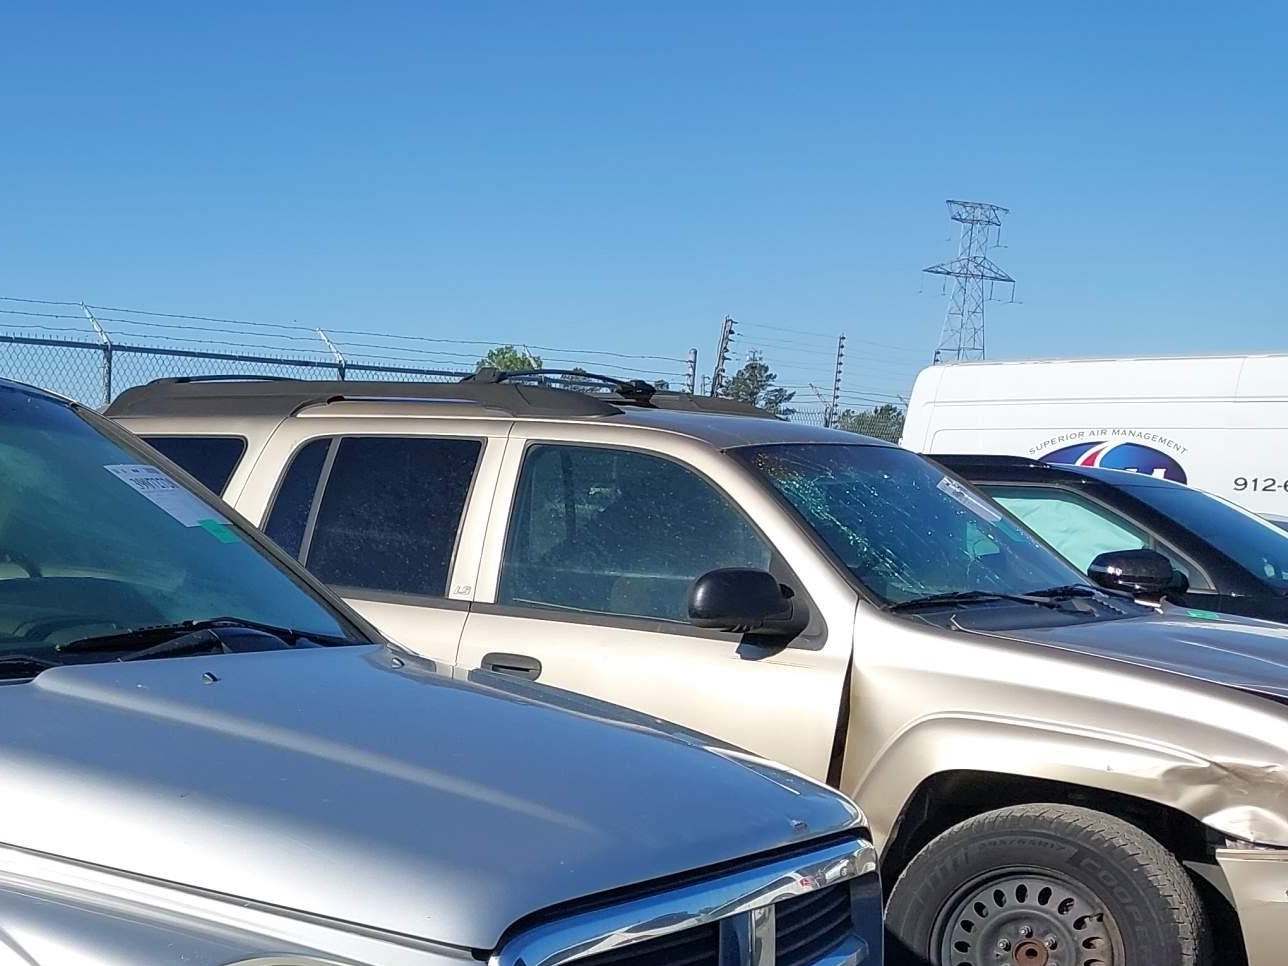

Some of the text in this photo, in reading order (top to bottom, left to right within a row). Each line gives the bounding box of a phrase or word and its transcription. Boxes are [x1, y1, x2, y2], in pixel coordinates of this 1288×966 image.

[1029, 429, 1188, 455] SUPERIOR AIR MANAGEMENT
